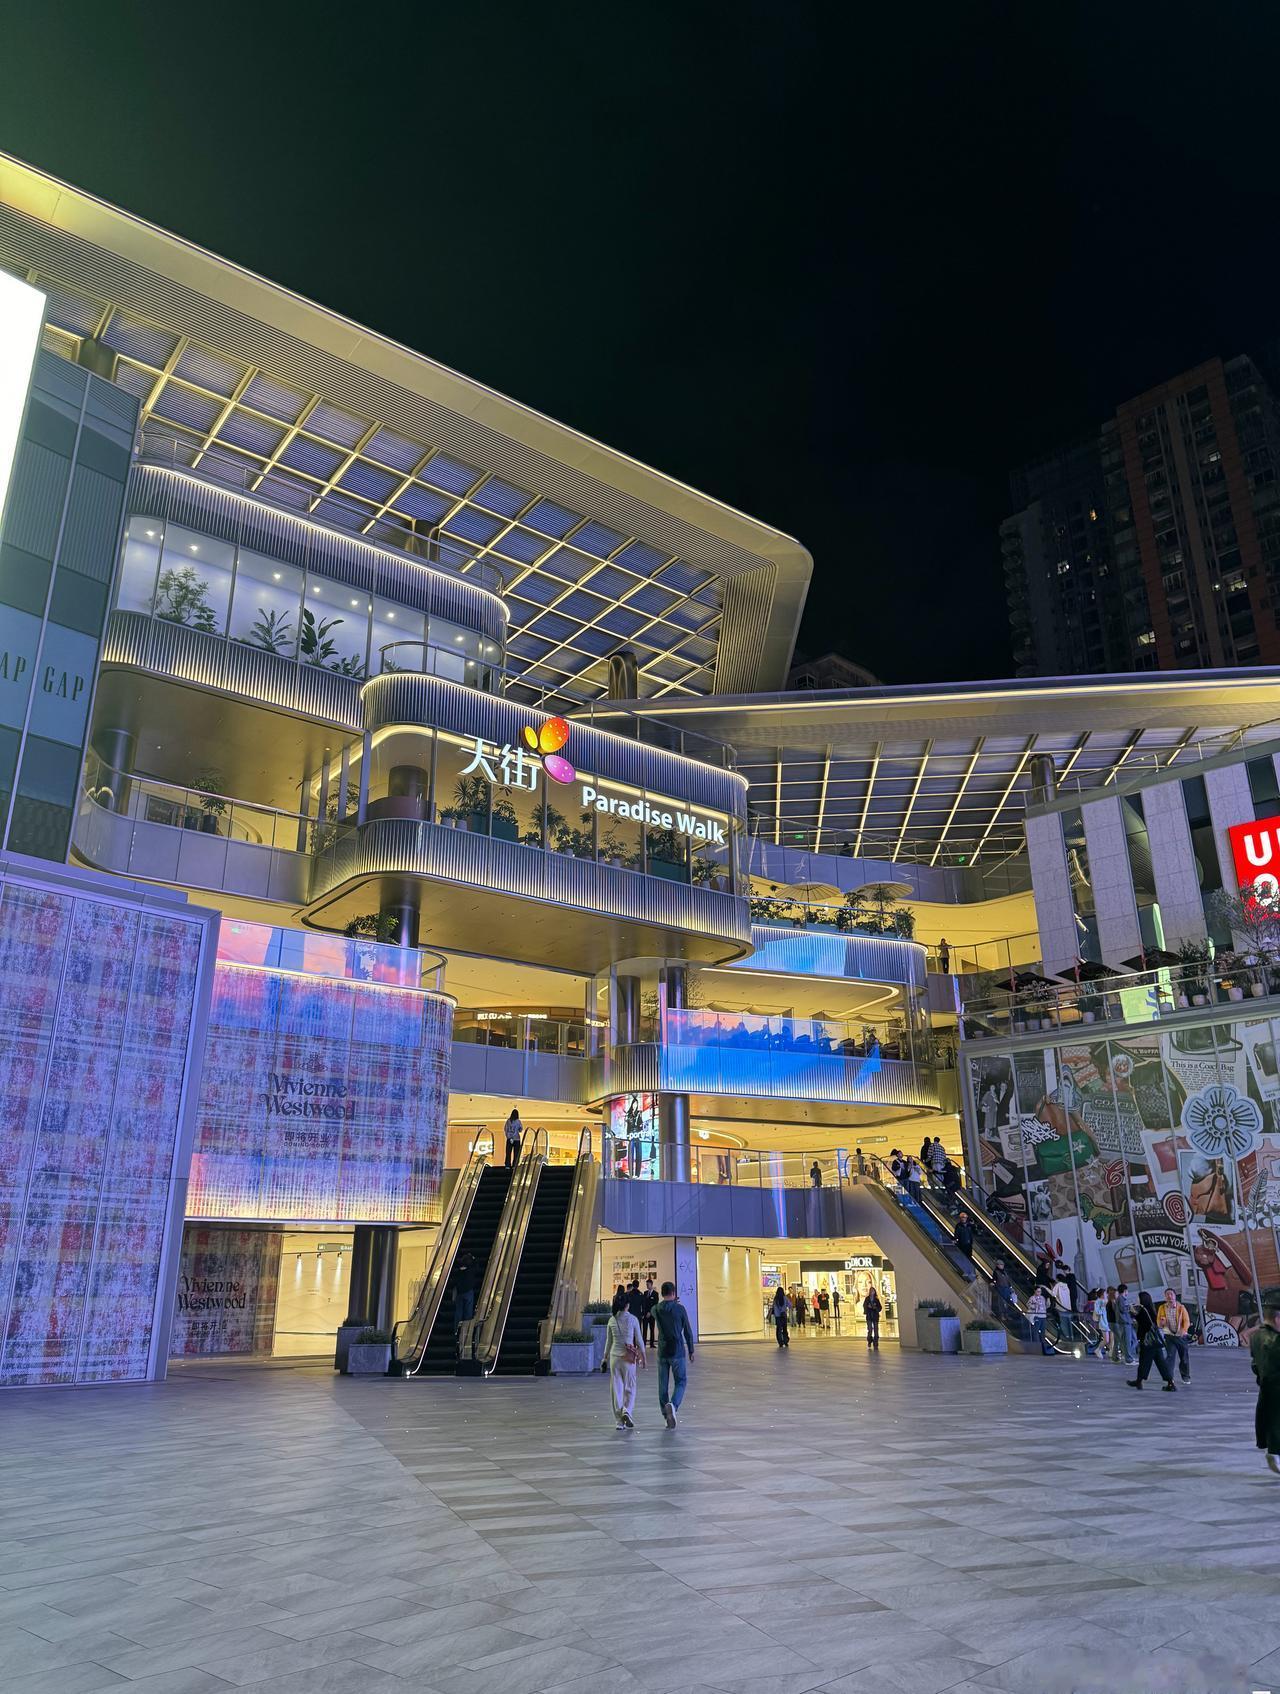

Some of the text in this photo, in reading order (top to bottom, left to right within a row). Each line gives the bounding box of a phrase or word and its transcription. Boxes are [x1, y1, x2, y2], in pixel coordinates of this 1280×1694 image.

[43, 665, 84, 701] GAP
[459, 733, 540, 792] 天街
[582, 786, 726, 845] Paradise Walk
[1171, 1060, 1186, 1068] This
[1220, 1063, 1234, 1072] Bag
[268, 1073, 348, 1098] Vivienne
[259, 1094, 356, 1120] Westwood
[284, 1131, 331, 1143] 即将开业
[1147, 1235, 1168, 1245] NEW
[851, 1257, 873, 1268] DIOR
[181, 1275, 240, 1293] Vivienne
[178, 1292, 246, 1312] Westwood
[1206, 1328, 1236, 1344] Coach
